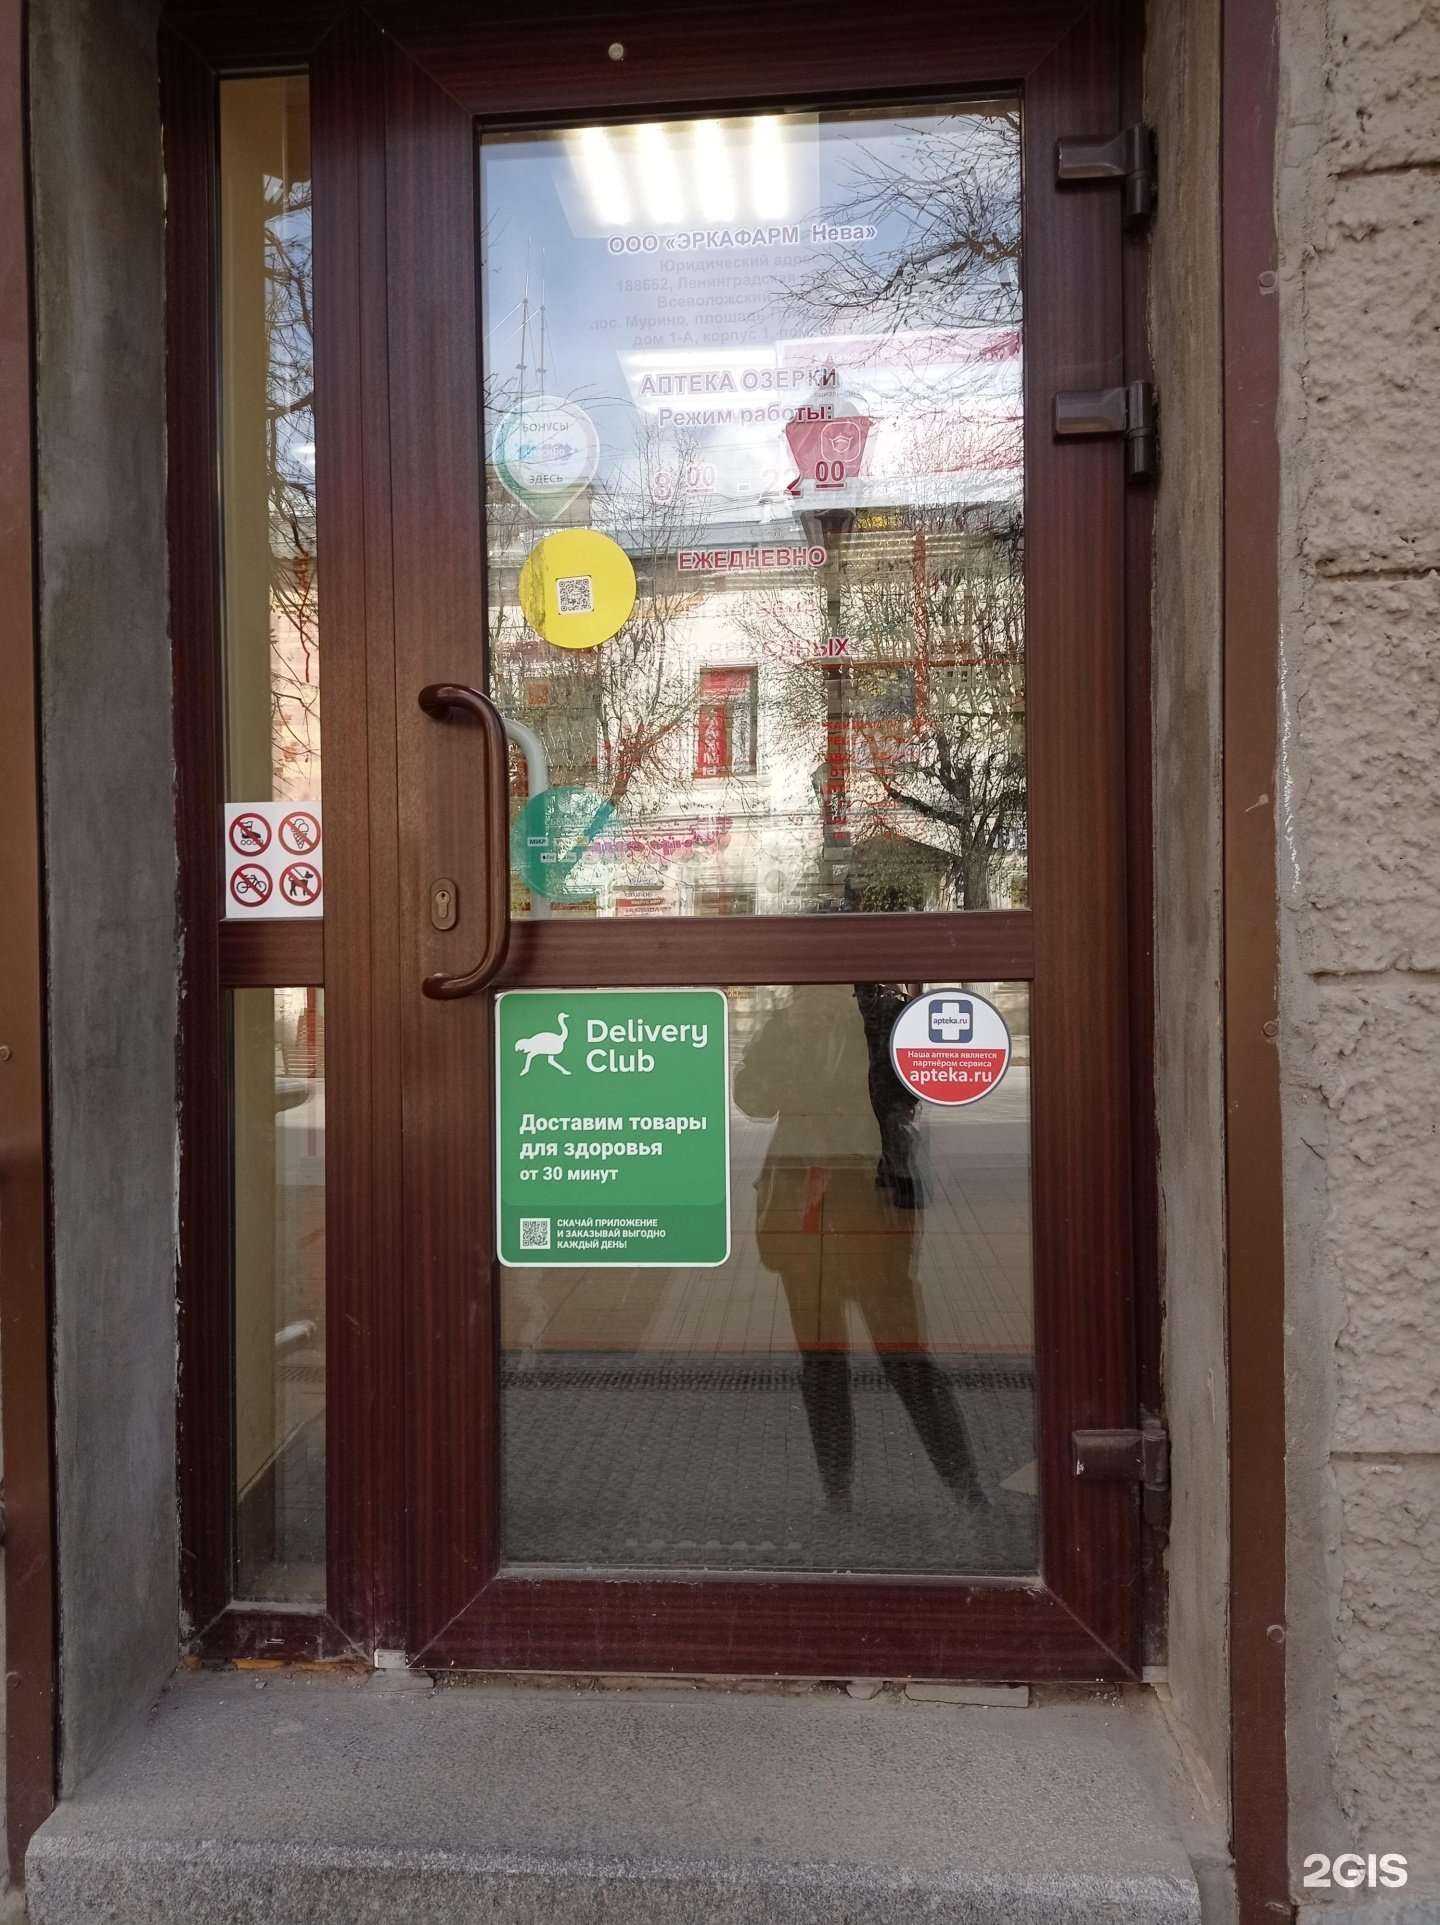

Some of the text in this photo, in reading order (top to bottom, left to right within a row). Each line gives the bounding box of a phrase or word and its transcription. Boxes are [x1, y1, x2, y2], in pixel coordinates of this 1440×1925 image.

[609, 223, 877, 253] ООО «ЭРКАФАРМ Нева»
[660, 254, 769, 273] Юридический
[640, 368, 837, 395] АПТЕКА ОЗЕРКИ
[659, 402, 833, 427] Режим работы:
[678, 547, 827, 570] ЕЖЕДНЕВНО
[932, 1016, 968, 1026] apteka.ru
[586, 1018, 709, 1048] Delivery
[586, 1048, 656, 1074] Club
[907, 1051, 998, 1060] Наша аптека является
[959, 1060, 992, 1069] сервиса
[910, 1067, 993, 1085] apteka.ru
[519, 1114, 707, 1135] Доставим товары
[519, 1141, 663, 1160] для здоровья
[519, 1166, 619, 1184] от 30 минут
[556, 1217, 659, 1228] СКАЧАЙ ПРИЛОЖЕНИЕ
[556, 1228, 667, 1239] И ЗАКАЗЫВАЙ ВЫГОДНО
[556, 1239, 628, 1251] КАЖДЫЙ ДЕНЬ!
